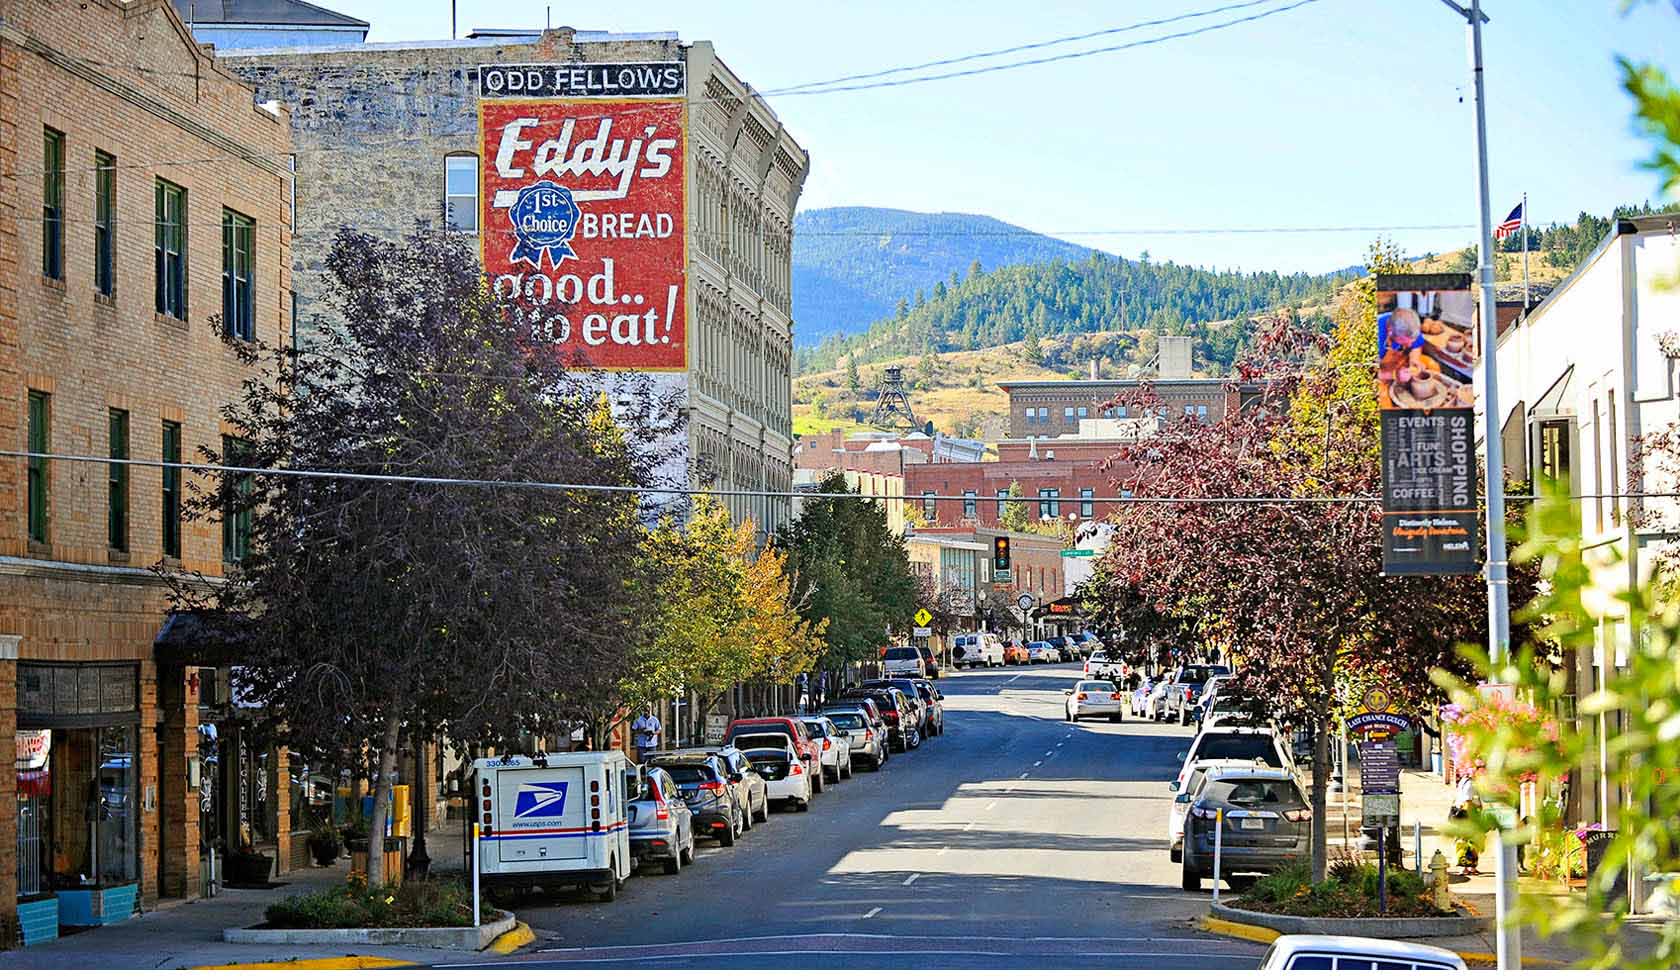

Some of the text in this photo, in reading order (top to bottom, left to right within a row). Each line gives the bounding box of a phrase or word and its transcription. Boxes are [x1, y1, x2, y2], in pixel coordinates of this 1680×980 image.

[486, 69, 680, 90] ODD FELLOWS
[493, 117, 677, 207] Eddy's
[533, 191, 560, 214] 1st
[522, 214, 568, 233] Choice
[583, 213, 674, 239] BREAD
[582, 284, 679, 346] eat!
[1398, 416, 1445, 428] EVENTS
[1396, 451, 1446, 468] ARTS
[1451, 416, 1468, 506] SHOPPING
[1392, 488, 1436, 499] COFFEE
[240, 739, 248, 765] ART
